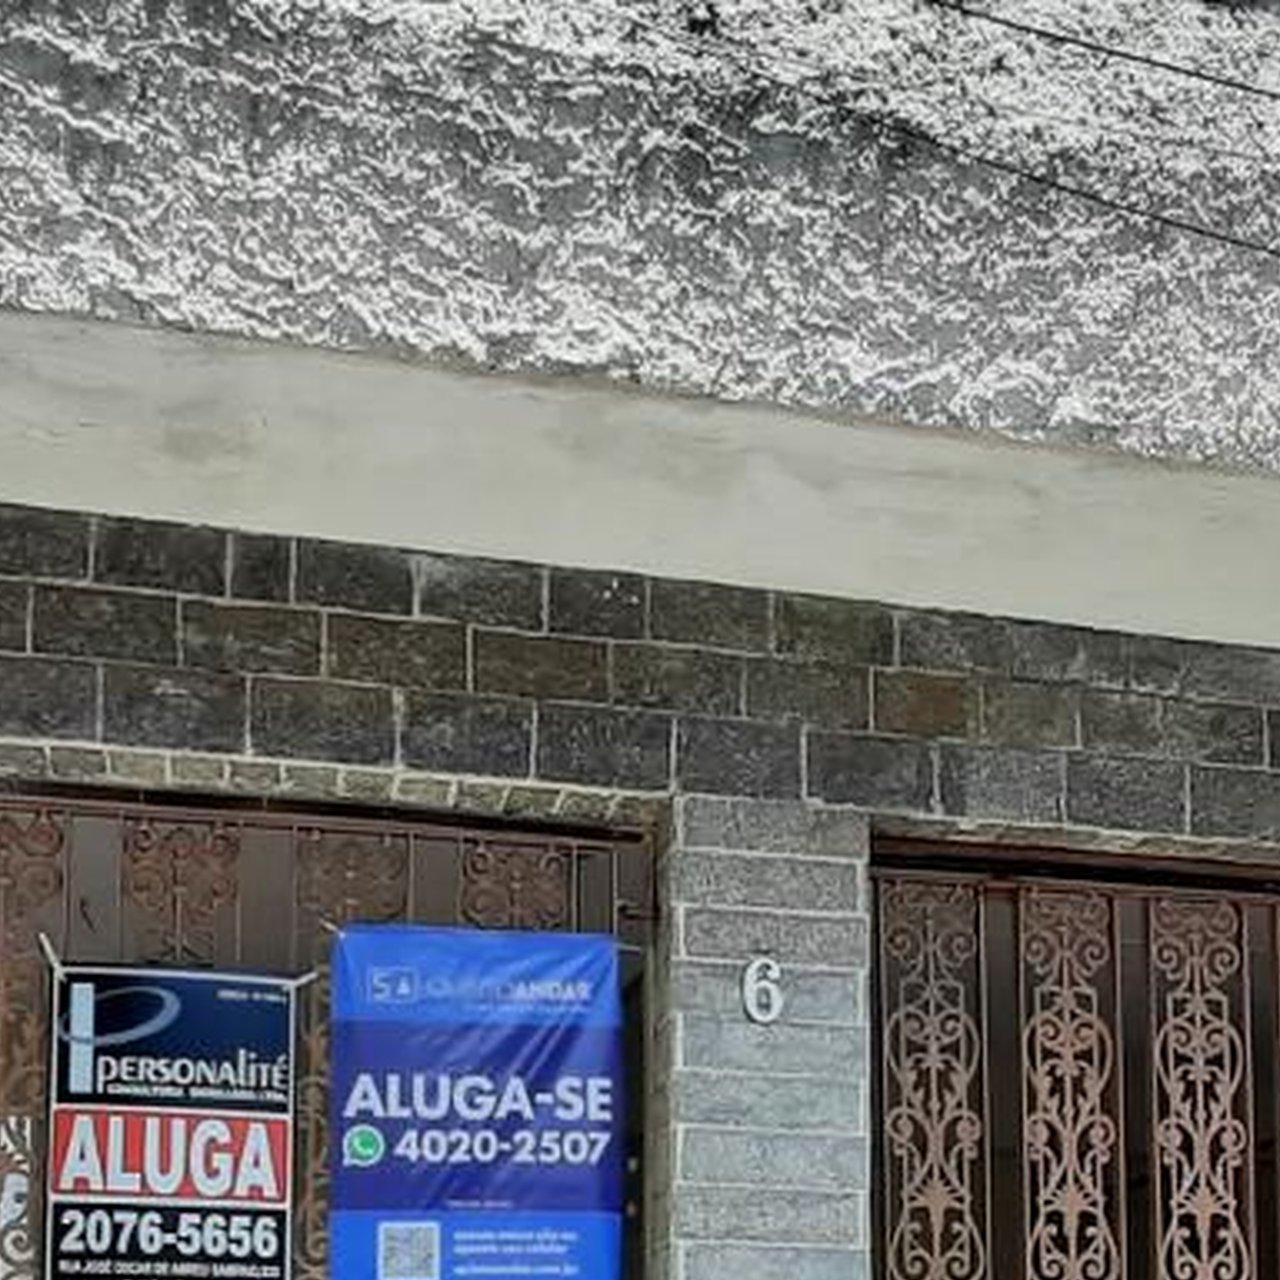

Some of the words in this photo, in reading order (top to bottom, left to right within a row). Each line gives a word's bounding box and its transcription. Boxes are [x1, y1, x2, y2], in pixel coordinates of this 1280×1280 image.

[742, 957, 784, 1023] 6
[343, 1072, 613, 1122] ALUGA-SE
[58, 1114, 280, 1197] ALUGA
[393, 1129, 612, 1165] 4020-2507
[58, 1209, 280, 1258] 2076-5656
